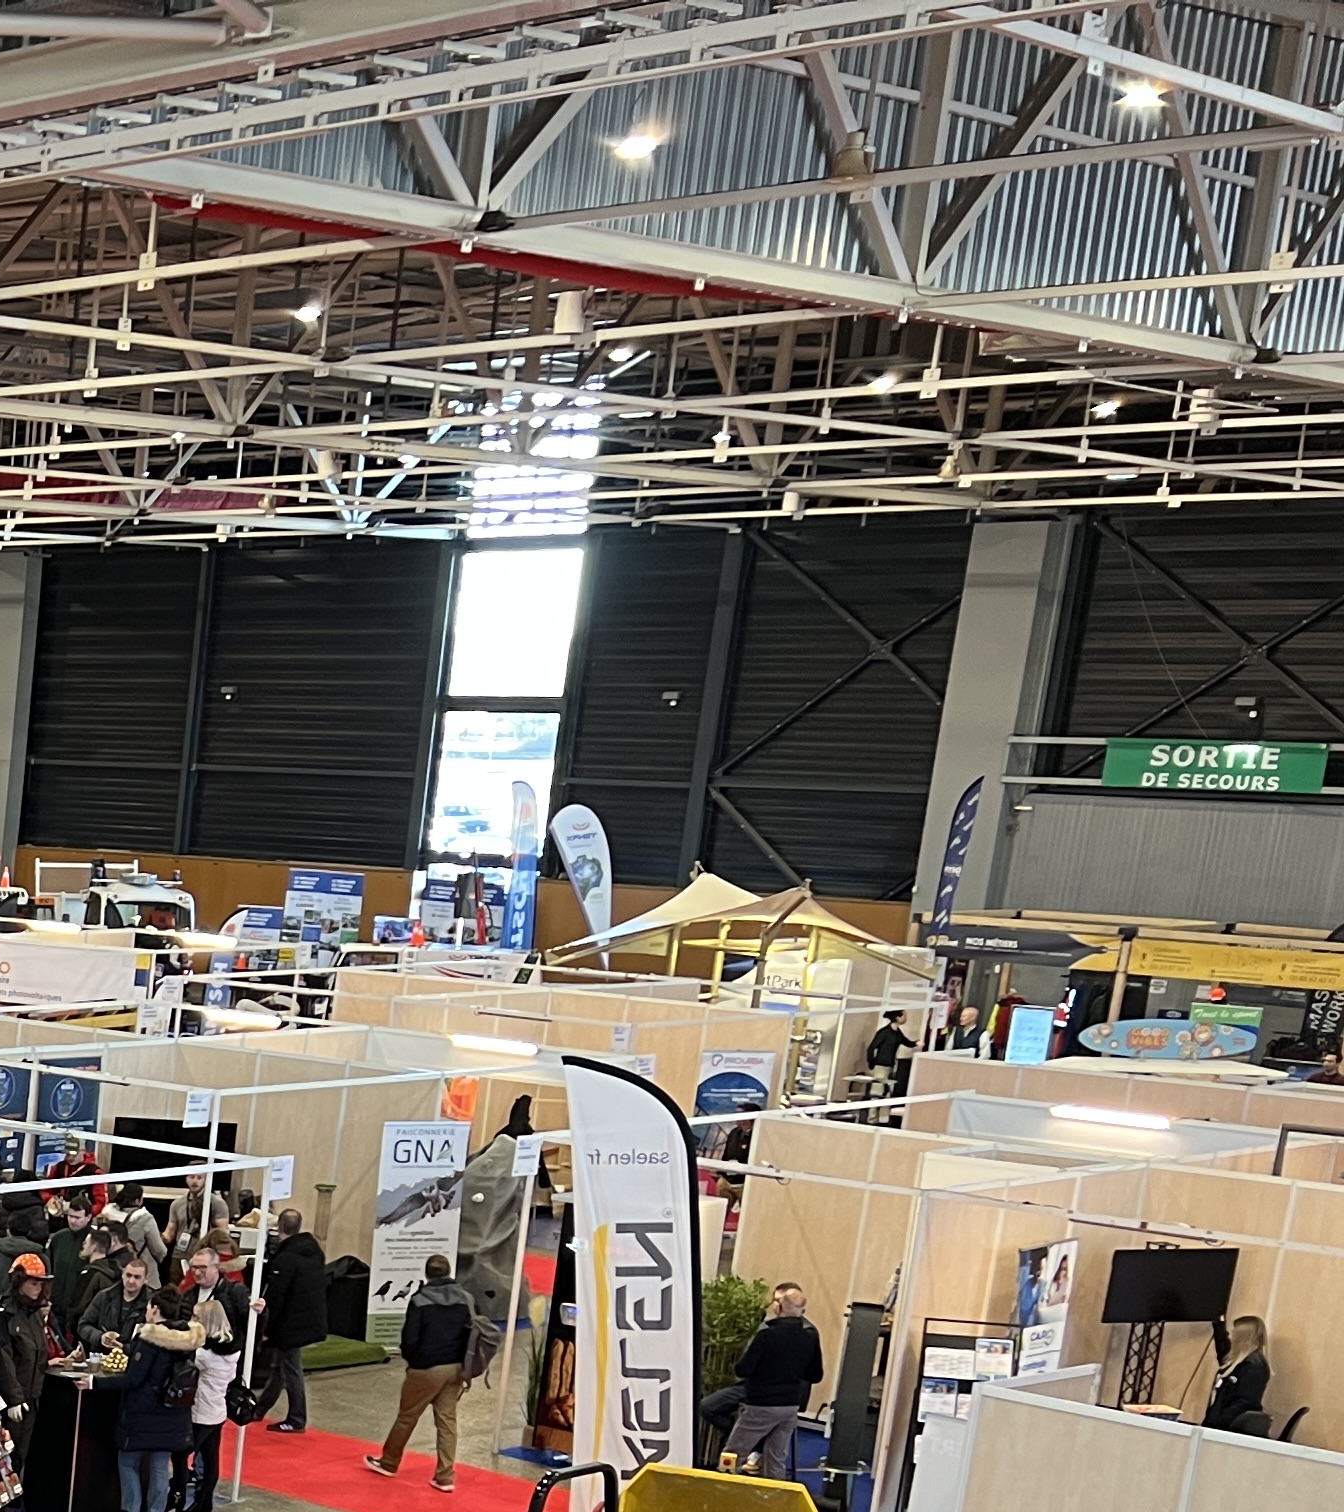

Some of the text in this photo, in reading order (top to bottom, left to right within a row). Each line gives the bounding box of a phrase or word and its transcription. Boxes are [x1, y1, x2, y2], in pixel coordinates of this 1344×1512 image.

[1149, 744, 1282, 771] SORTIE
[1141, 772, 1280, 792] DE SECOURS
[393, 1139, 455, 1164] GNA
